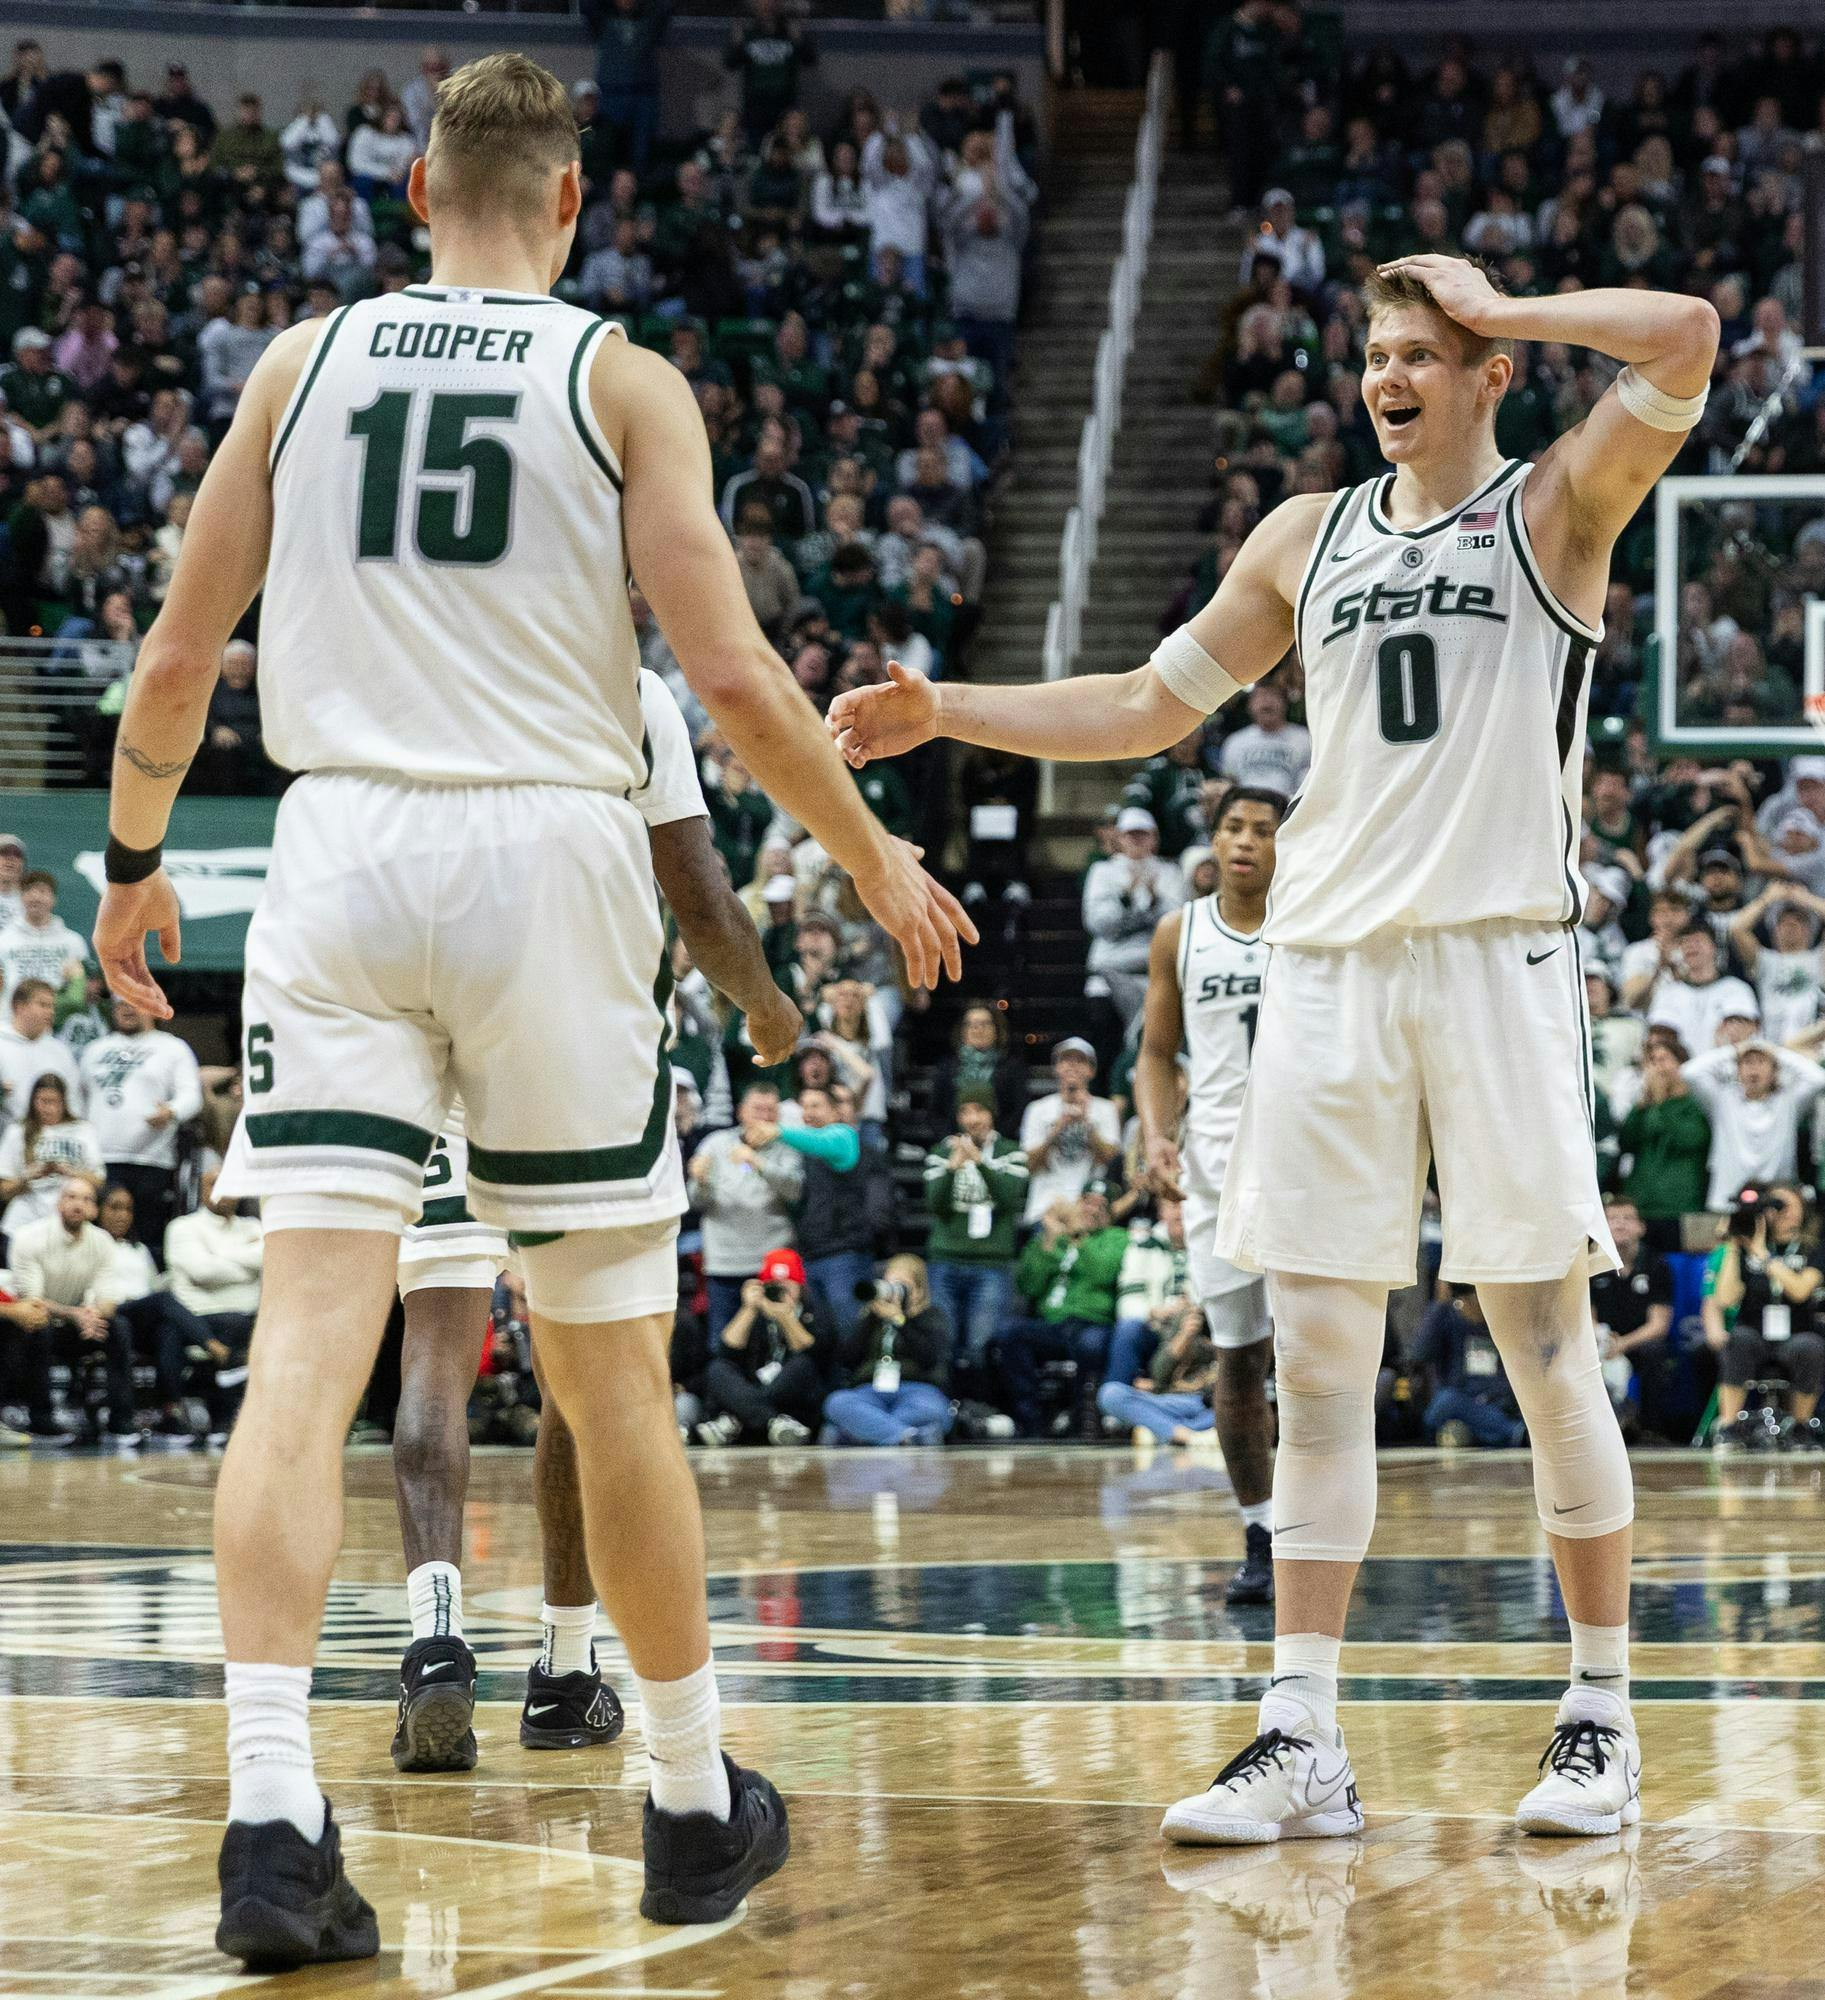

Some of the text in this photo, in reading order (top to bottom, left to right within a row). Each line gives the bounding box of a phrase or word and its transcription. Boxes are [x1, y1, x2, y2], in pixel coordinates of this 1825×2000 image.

[368, 321, 534, 364] COOPER
[344, 386, 525, 569] 15
[1377, 630, 1442, 747] 0
[1197, 972, 1262, 1005] Sta
[247, 1021, 275, 1095] S
